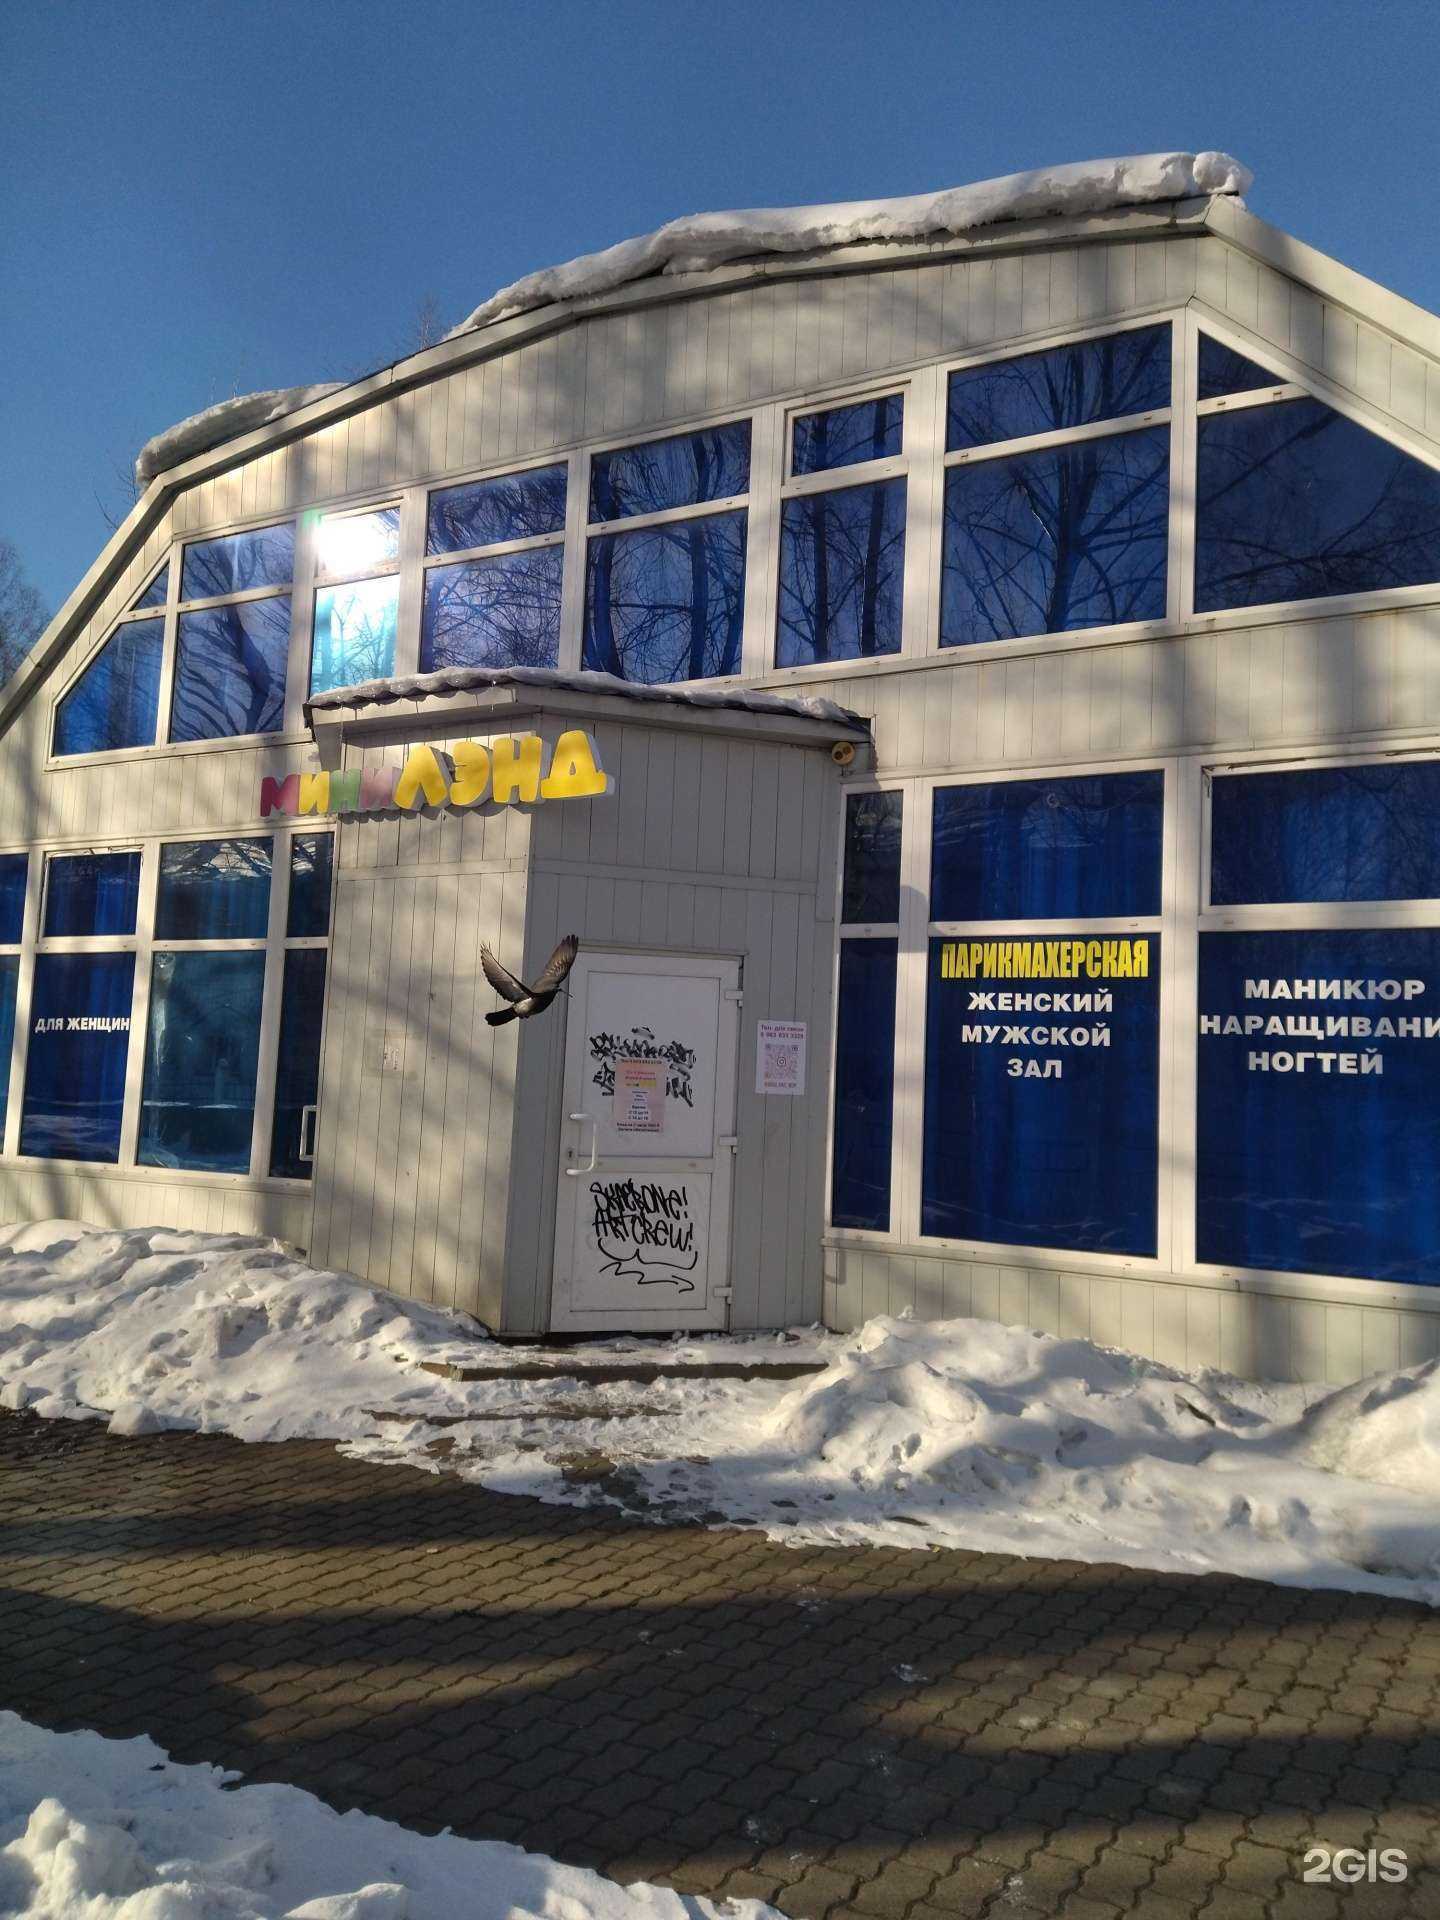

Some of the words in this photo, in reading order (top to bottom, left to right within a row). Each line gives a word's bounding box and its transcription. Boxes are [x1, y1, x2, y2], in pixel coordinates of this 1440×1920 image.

[260, 730, 608, 817] МИНИЛЭНД
[941, 940, 1149, 979] ПАРИКМАХЕРСКАЯ
[968, 988, 1113, 1013] ЖЕНСКИЙ
[1244, 979, 1426, 1001] МАНИКЮР
[35, 1018, 64, 1033] ДЛЯ
[66, 1016, 130, 1032] ЖЕНЩИН
[961, 1022, 1111, 1048] МУЖСКОЙ
[1007, 1057, 1063, 1079] ЗАЛ
[1249, 1048, 1384, 1075] НОГТЕЙ
